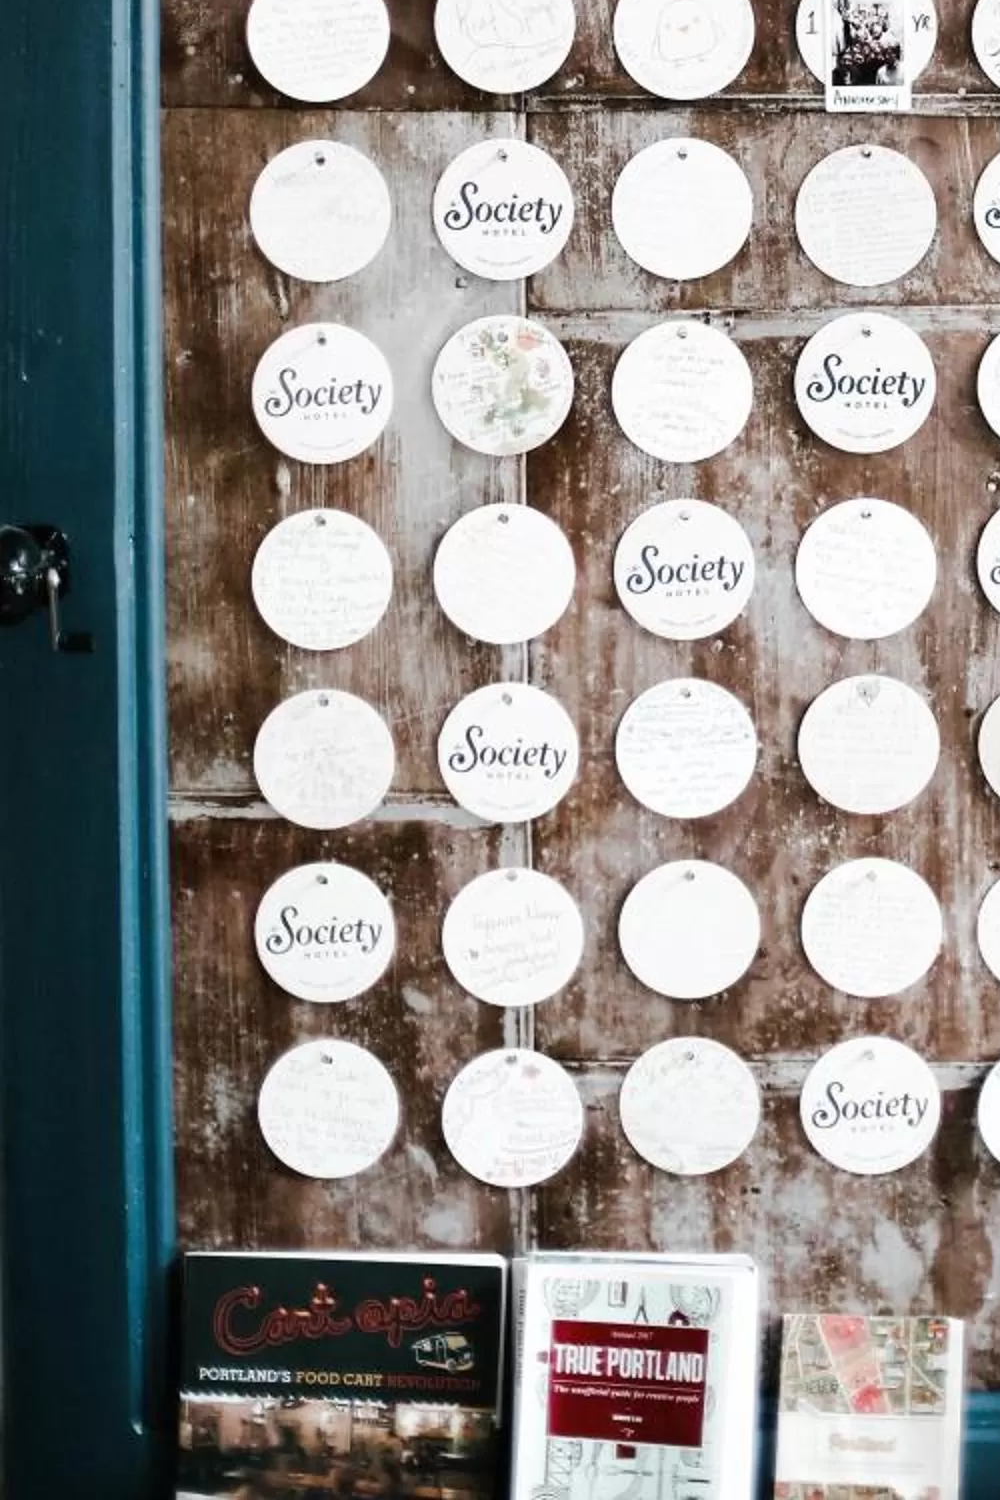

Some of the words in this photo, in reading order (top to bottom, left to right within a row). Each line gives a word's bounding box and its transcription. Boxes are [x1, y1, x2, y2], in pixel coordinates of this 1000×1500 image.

[443, 182, 563, 234] Society
[264, 368, 382, 417] Society
[806, 353, 926, 408] Society
[626, 545, 744, 594] Society
[448, 725, 567, 775] Society
[265, 907, 382, 954] Society
[812, 1082, 929, 1128] Society
[199, 1366, 292, 1384] PORTLAND'S
[296, 1371, 341, 1387] FOOD
[342, 1372, 384, 1389] CART
[553, 1343, 603, 1377] TRUE
[606, 1347, 704, 1383] PORTLAND
